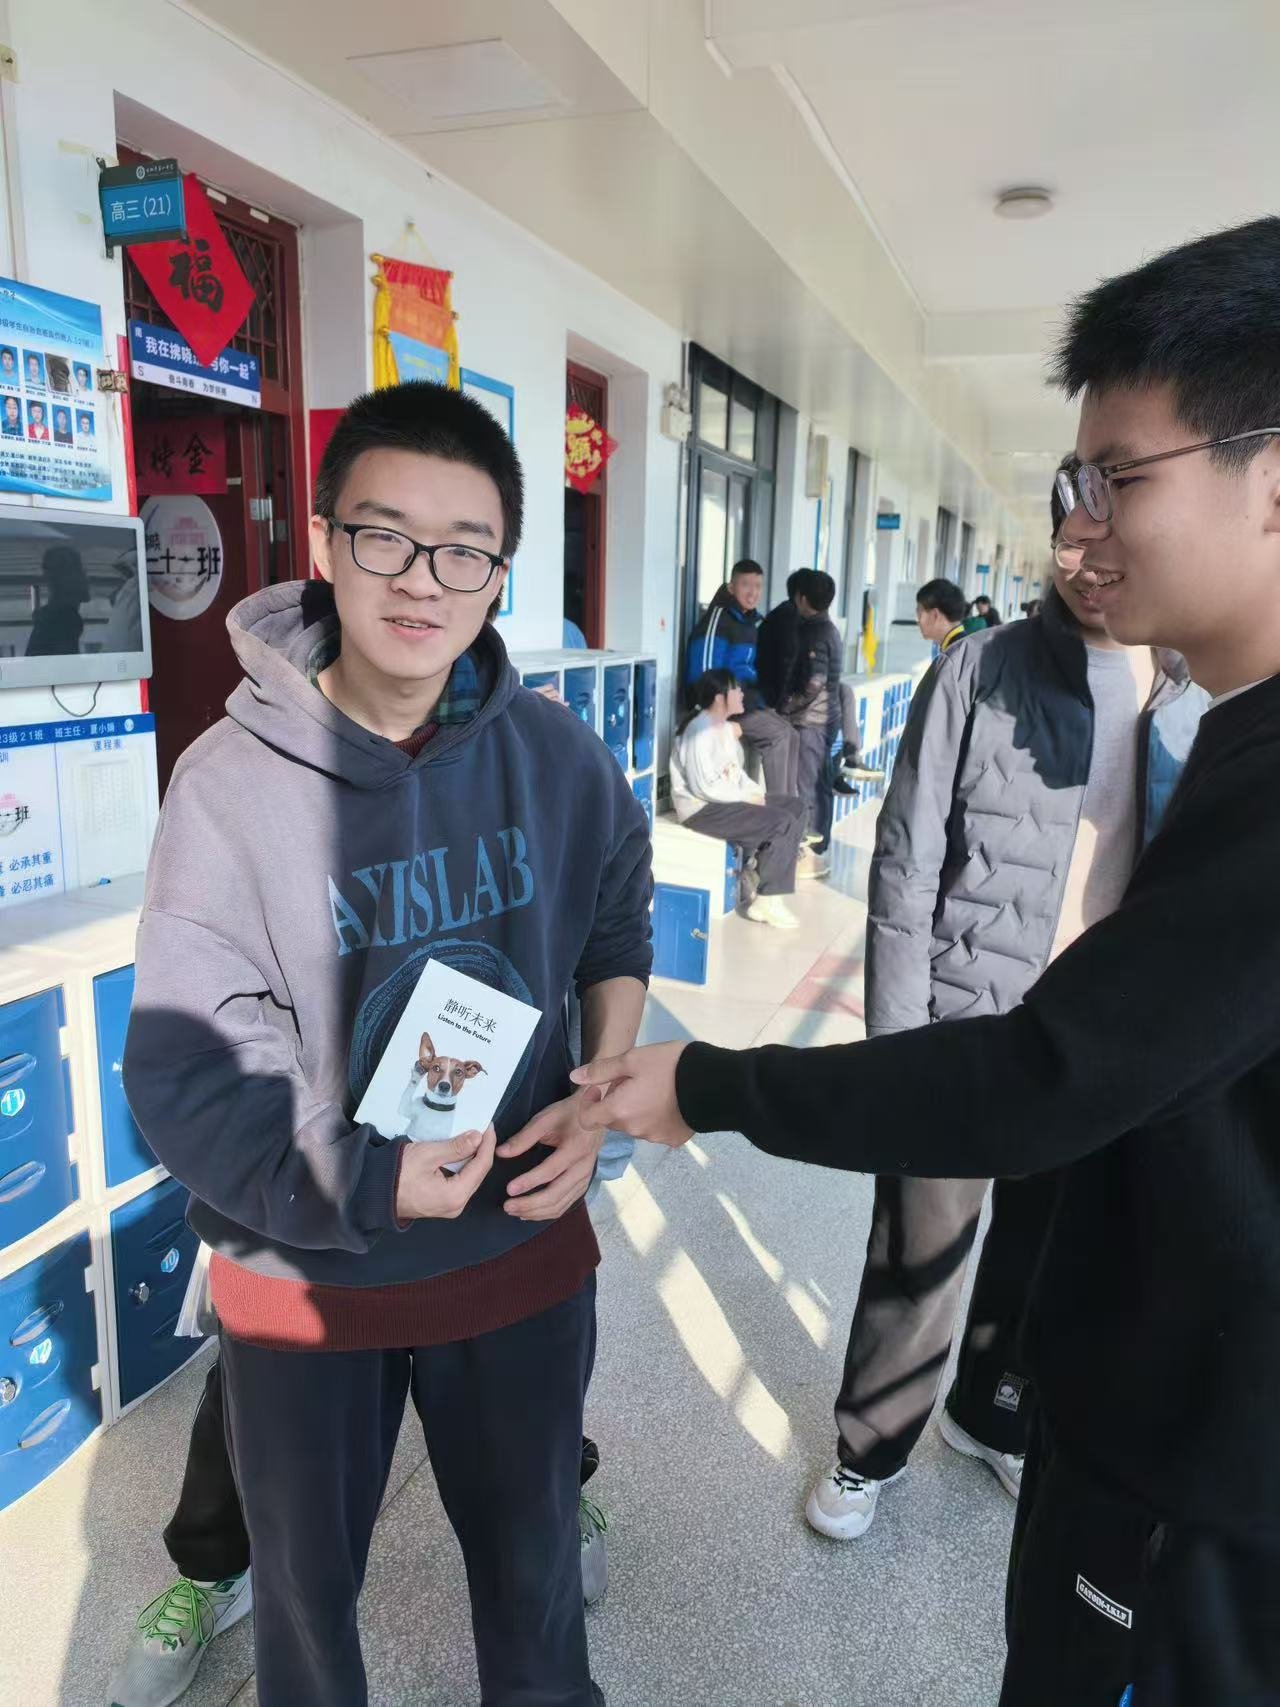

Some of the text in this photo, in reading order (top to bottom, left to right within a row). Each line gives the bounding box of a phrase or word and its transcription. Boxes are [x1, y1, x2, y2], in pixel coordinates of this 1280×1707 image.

[110, 194, 172, 223] 高三(21)
[168, 239, 224, 314] 福
[138, 365, 145, 377] S
[438, 1013, 454, 1025] Listen
[462, 1026, 472, 1034] the
[472, 1030, 491, 1043] Future
[443, 998, 496, 1033] 静听未来
